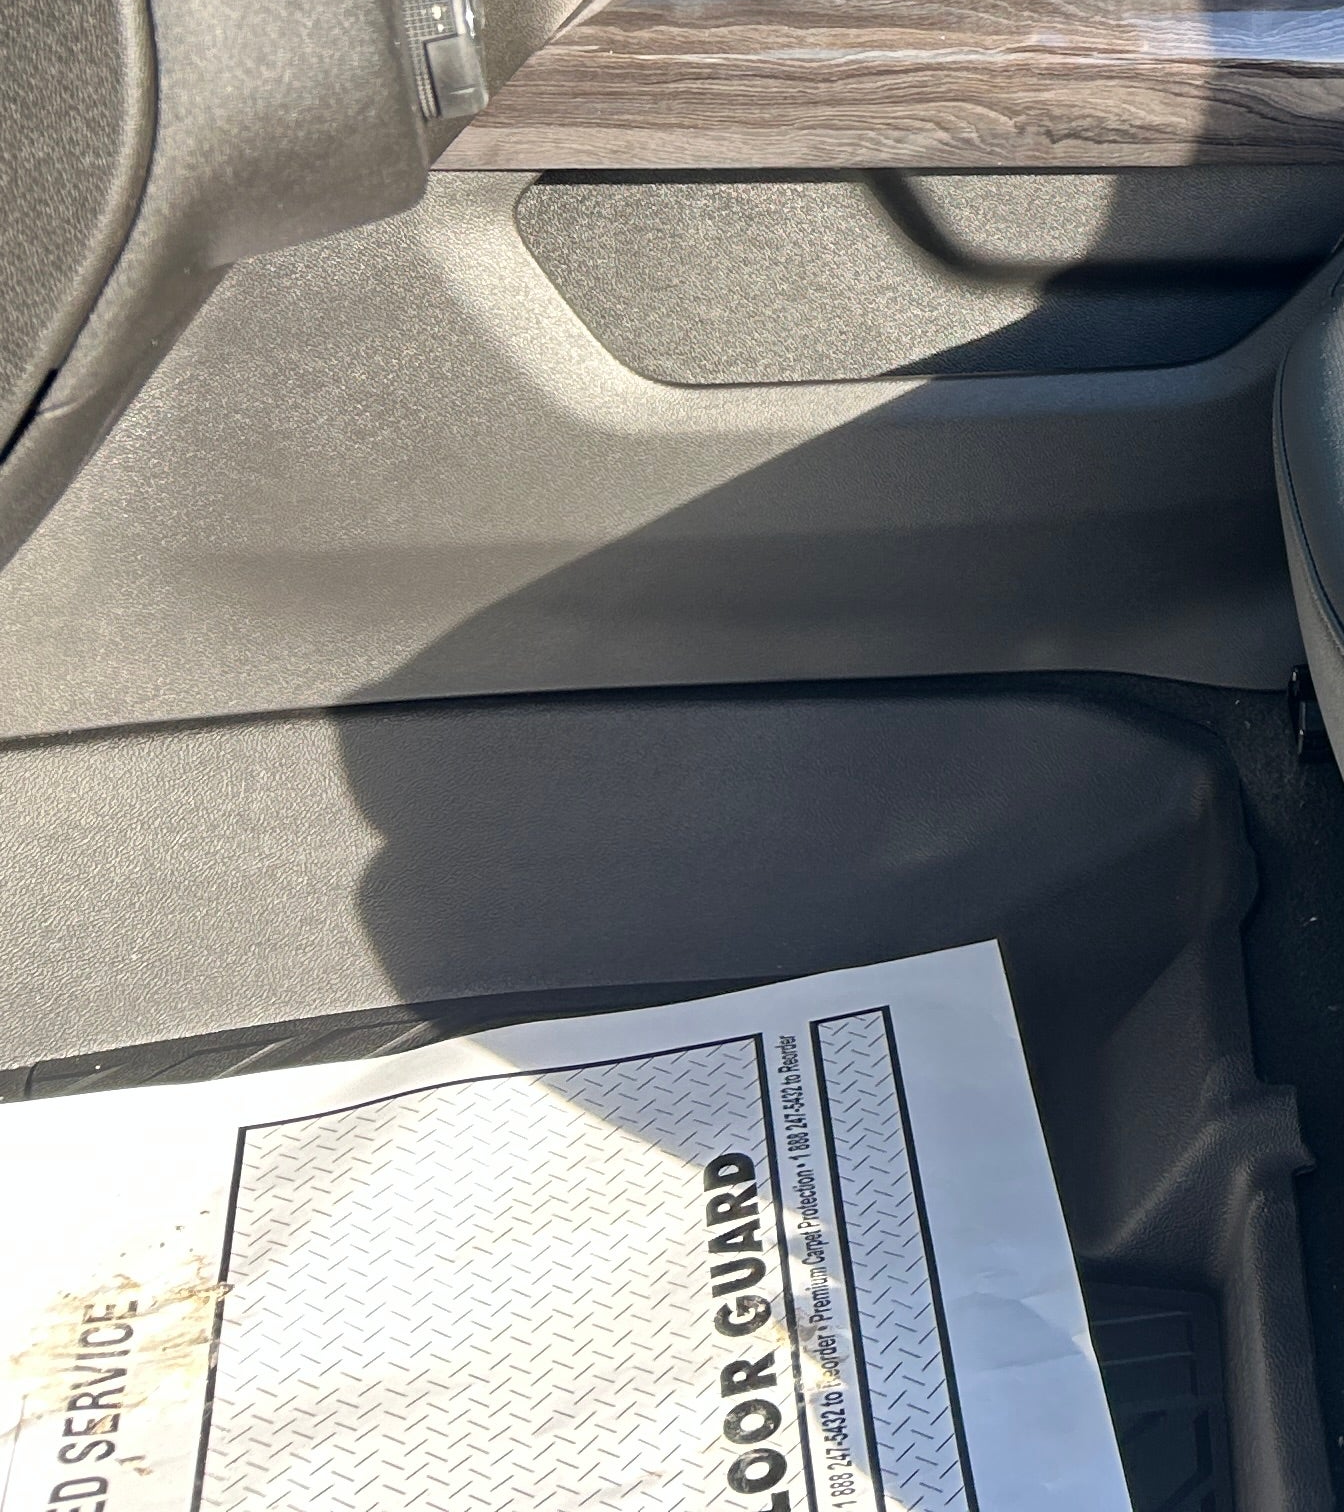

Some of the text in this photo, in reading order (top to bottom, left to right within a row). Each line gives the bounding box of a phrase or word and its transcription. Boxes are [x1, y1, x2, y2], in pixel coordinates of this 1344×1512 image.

[775, 1035, 800, 1074] Reorder
[781, 1074, 801, 1085] to
[787, 1132, 810, 1152] 888
[794, 1168, 820, 1230] Protection
[703, 1152, 772, 1337] GUARD
[801, 1232, 829, 1265] Carpet
[806, 1266, 833, 1324] Premium
[57, 1300, 138, 1464] SERVICE
[824, 1391, 844, 1407] to
[821, 1407, 853, 1471] 247-5432
[829, 1472, 856, 1497] 888
